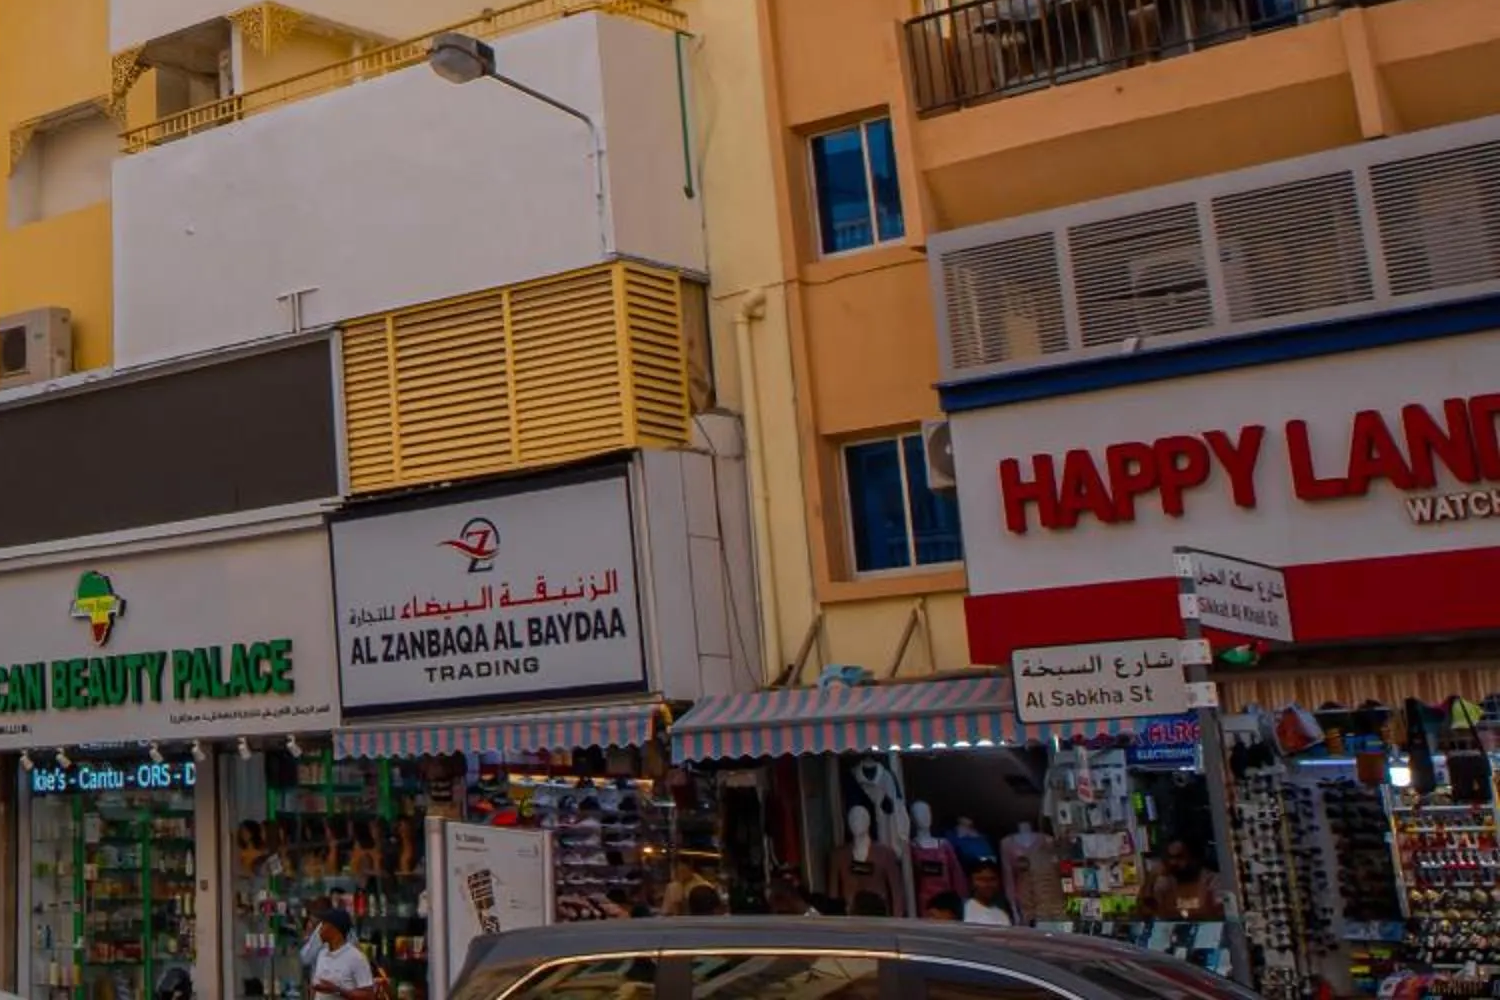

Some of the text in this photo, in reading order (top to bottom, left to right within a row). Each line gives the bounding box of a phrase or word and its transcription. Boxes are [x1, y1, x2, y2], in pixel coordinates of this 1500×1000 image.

[999, 424, 1265, 535] HAPPY
[349, 568, 618, 627] الزنبقة البيضاء للتجارة
[351, 607, 626, 666] AL ZANBAQA AL BAYDAA
[51, 651, 167, 711] BEAUTY
[172, 638, 295, 701] PALACE
[425, 656, 541, 683] TRADING
[1022, 651, 1174, 681] شارع السبخة
[1025, 685, 1153, 708] Al Sabkha St
[79, 767, 124, 789] Cantu
